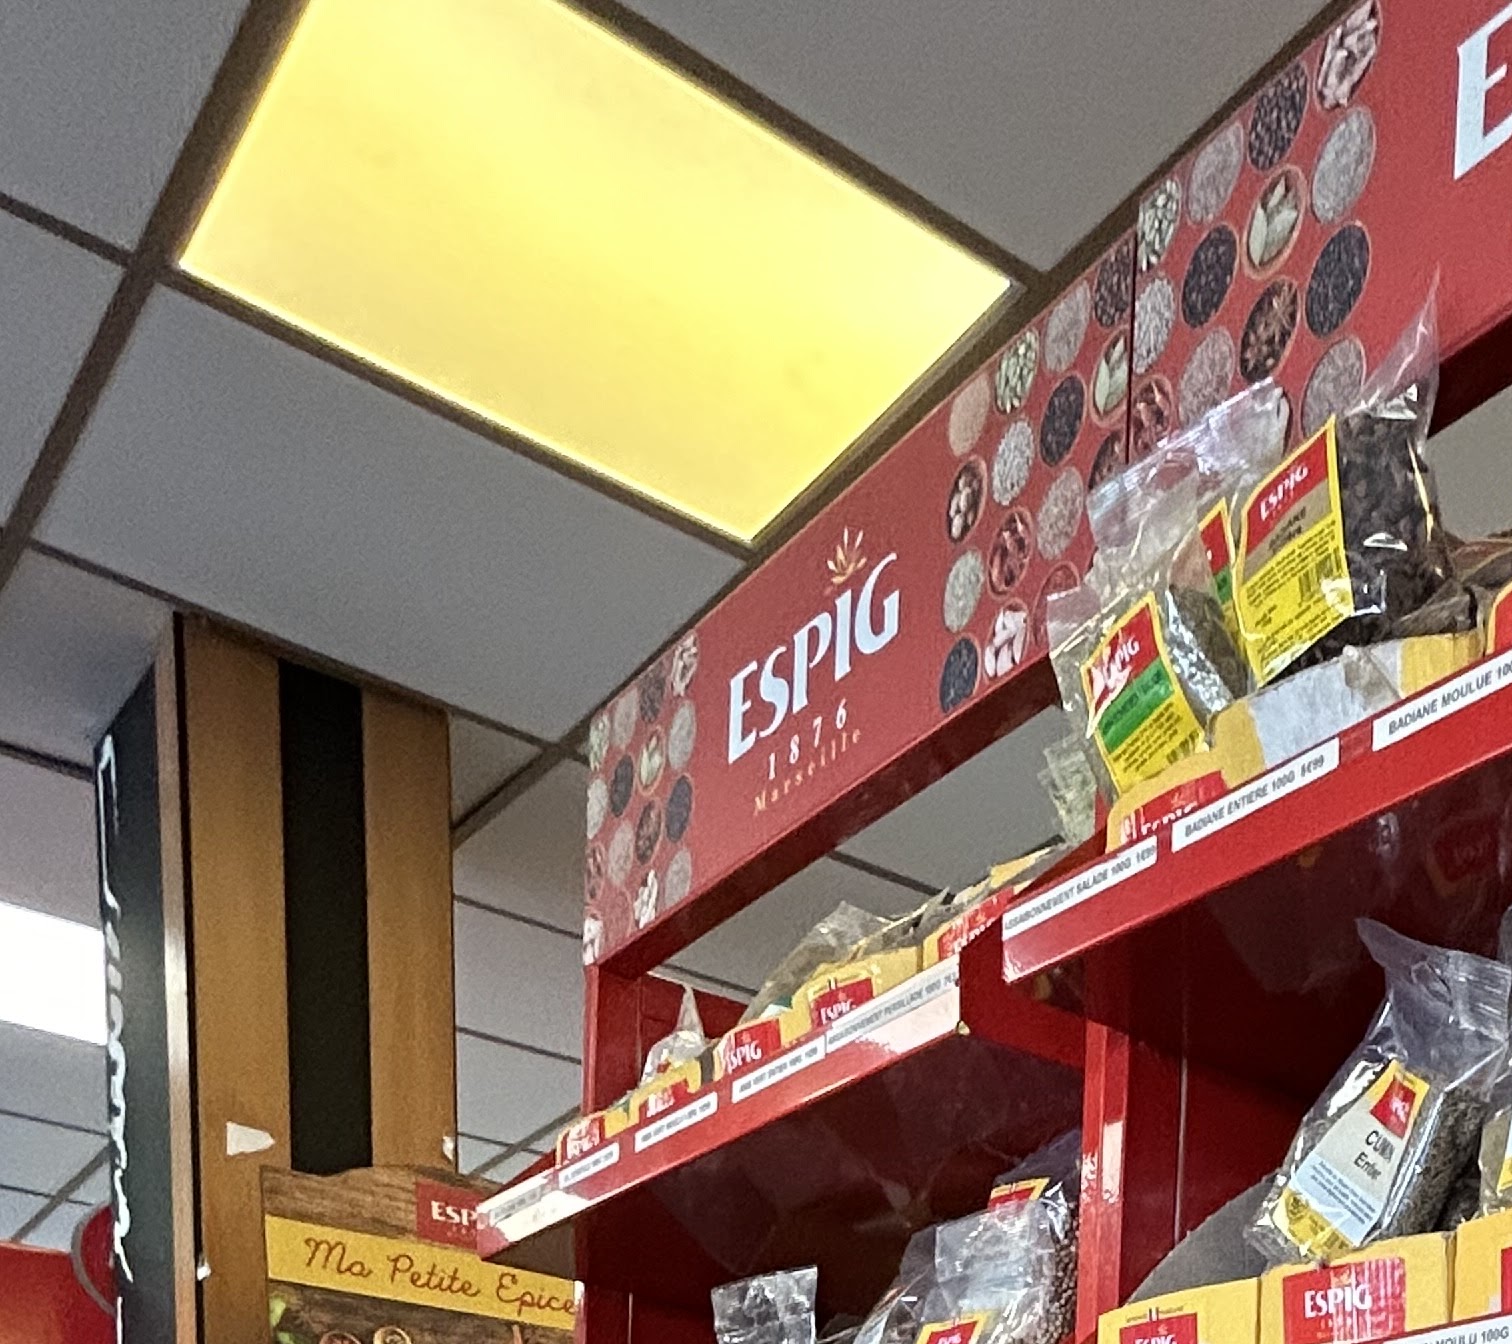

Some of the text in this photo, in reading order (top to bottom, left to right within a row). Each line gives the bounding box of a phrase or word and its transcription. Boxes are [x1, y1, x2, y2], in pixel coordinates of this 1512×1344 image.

[727, 553, 900, 764] ESPIG
[1441, 669, 1492, 708] MOULUE
[768, 699, 849, 776] 1876
[430, 1201, 478, 1227] ESP
[304, 1236, 482, 1298] Ma Petite
